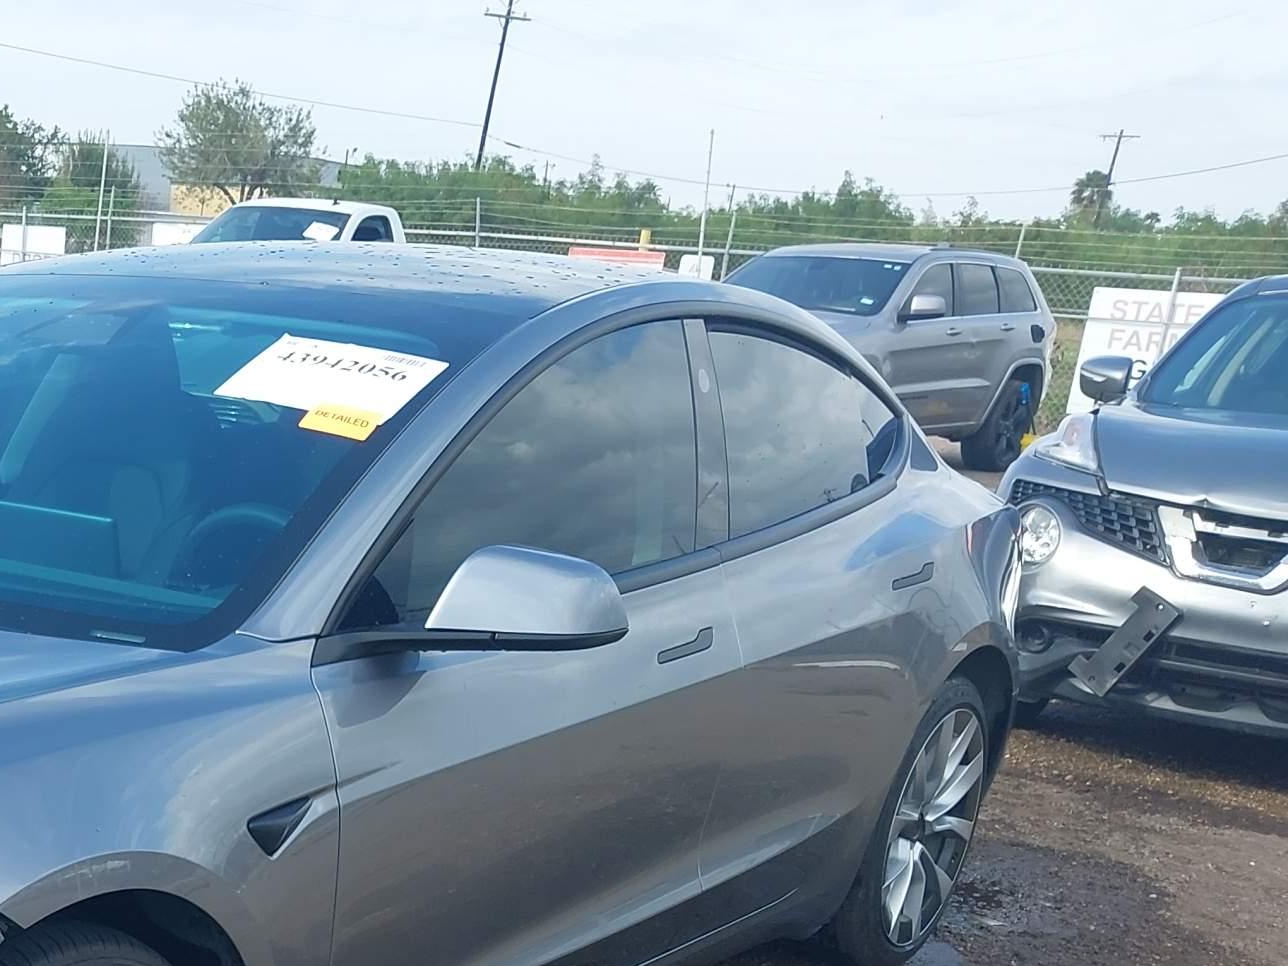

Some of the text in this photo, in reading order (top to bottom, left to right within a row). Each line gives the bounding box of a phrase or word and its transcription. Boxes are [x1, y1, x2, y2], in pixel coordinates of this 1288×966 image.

[1109, 299, 1204, 324] STATE
[278, 351, 408, 380] 43942056
[314, 409, 369, 429] DETAILED
